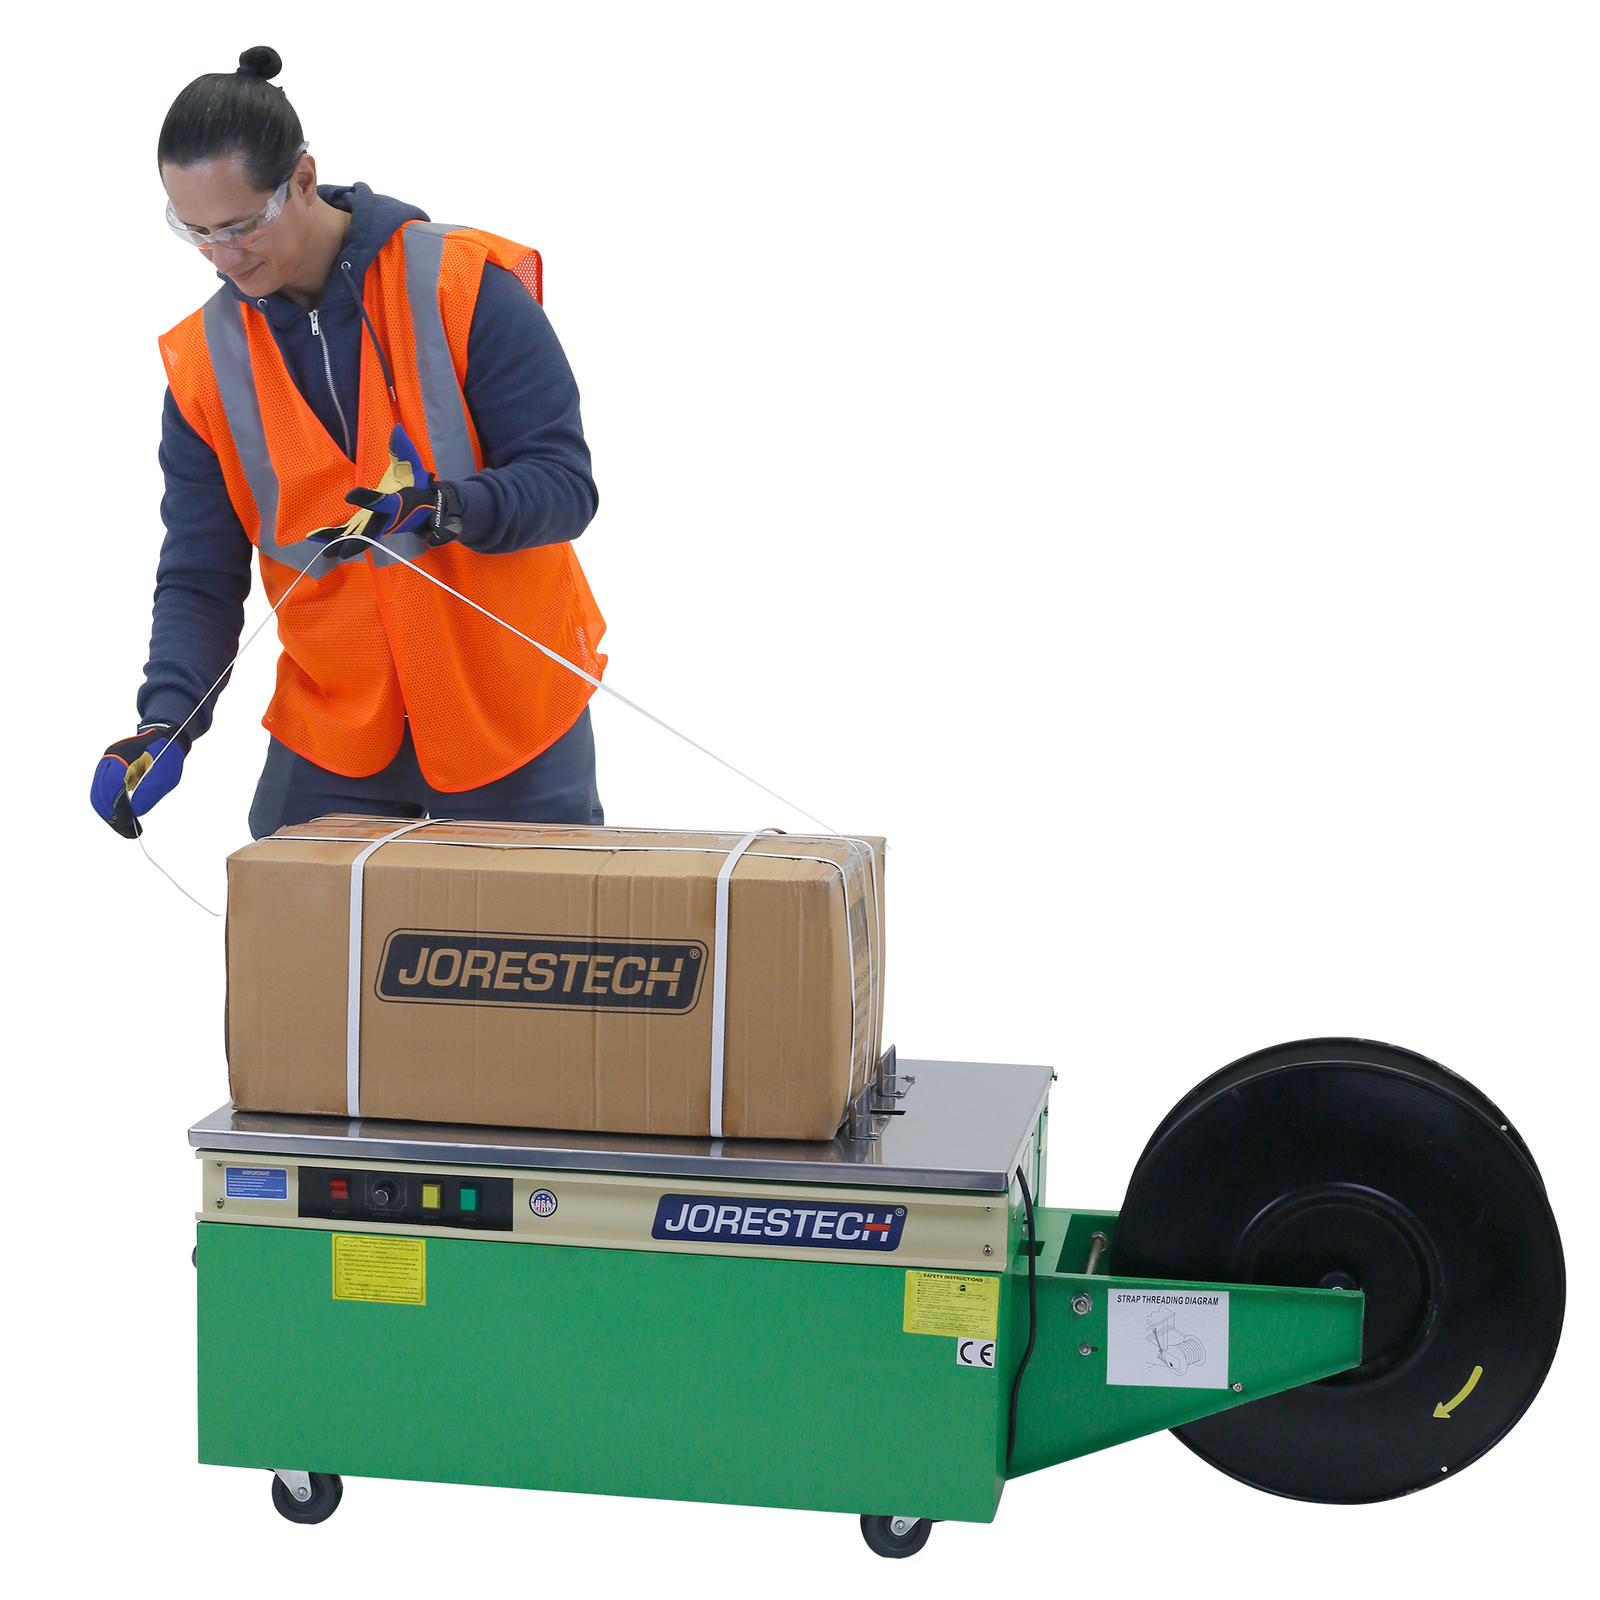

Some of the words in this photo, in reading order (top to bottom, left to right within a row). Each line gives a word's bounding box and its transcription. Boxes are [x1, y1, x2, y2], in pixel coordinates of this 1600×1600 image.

[397, 946, 685, 997] JORESTECH
[535, 1198, 551, 1208] USA
[664, 1202, 894, 1243] JORESTECH
[944, 1275, 983, 1283] INSTRUCTIONS
[1116, 1294, 1141, 1304] STRAP
[1142, 1295, 1184, 1305] THREADING
[1185, 1296, 1220, 1306] DIAGRAM
